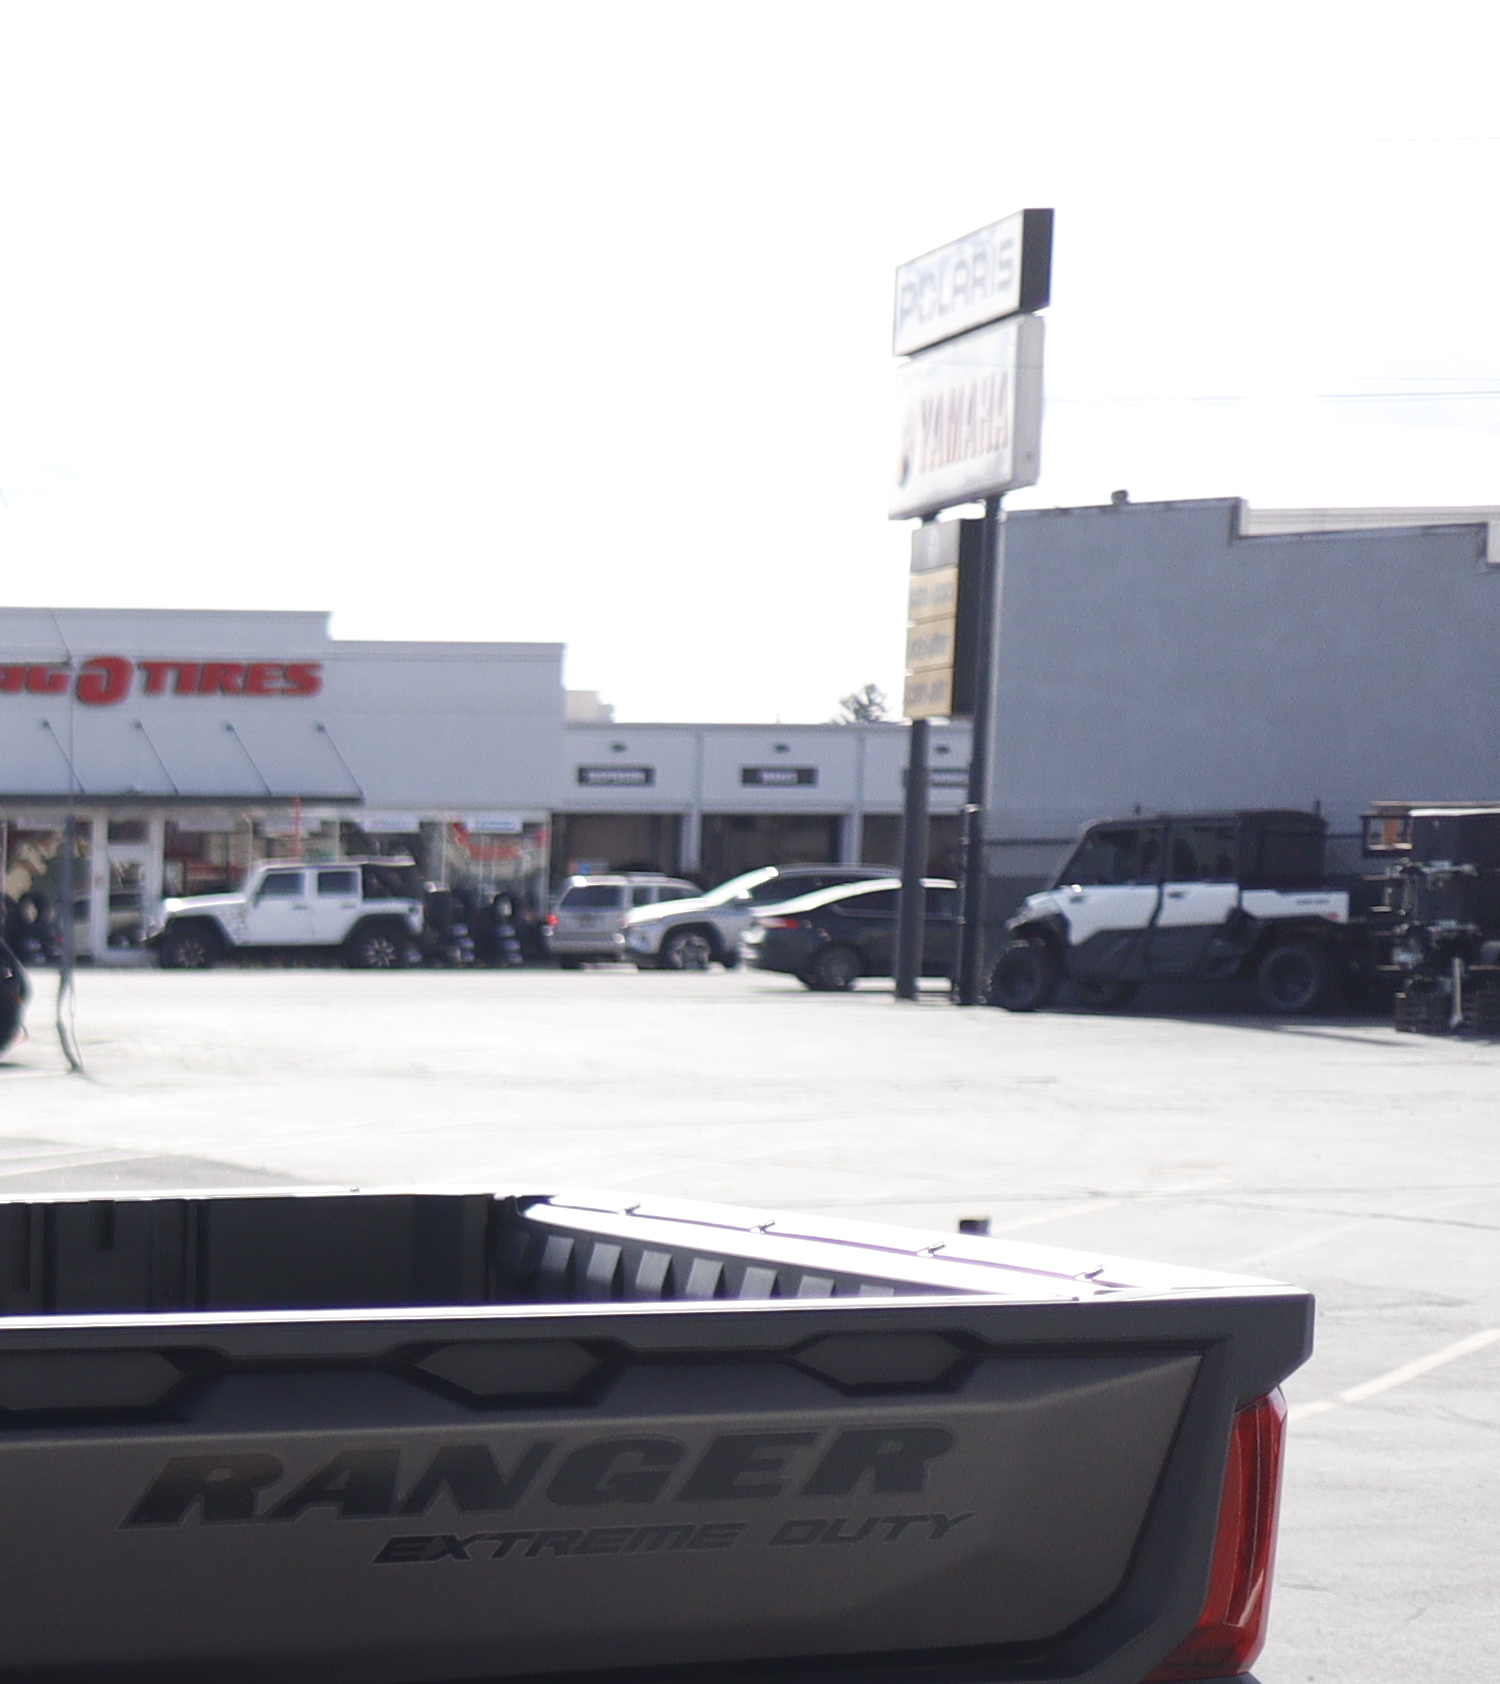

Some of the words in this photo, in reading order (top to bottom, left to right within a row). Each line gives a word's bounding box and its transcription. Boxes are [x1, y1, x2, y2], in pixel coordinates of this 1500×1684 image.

[899, 237, 1014, 331] POLARIS
[918, 367, 1009, 475] YAMAHA
[137, 660, 324, 697] TIRES
[116, 1423, 957, 1531] RANGER
[372, 1521, 746, 1564] EXTREME
[768, 1511, 979, 1547] DUTY
